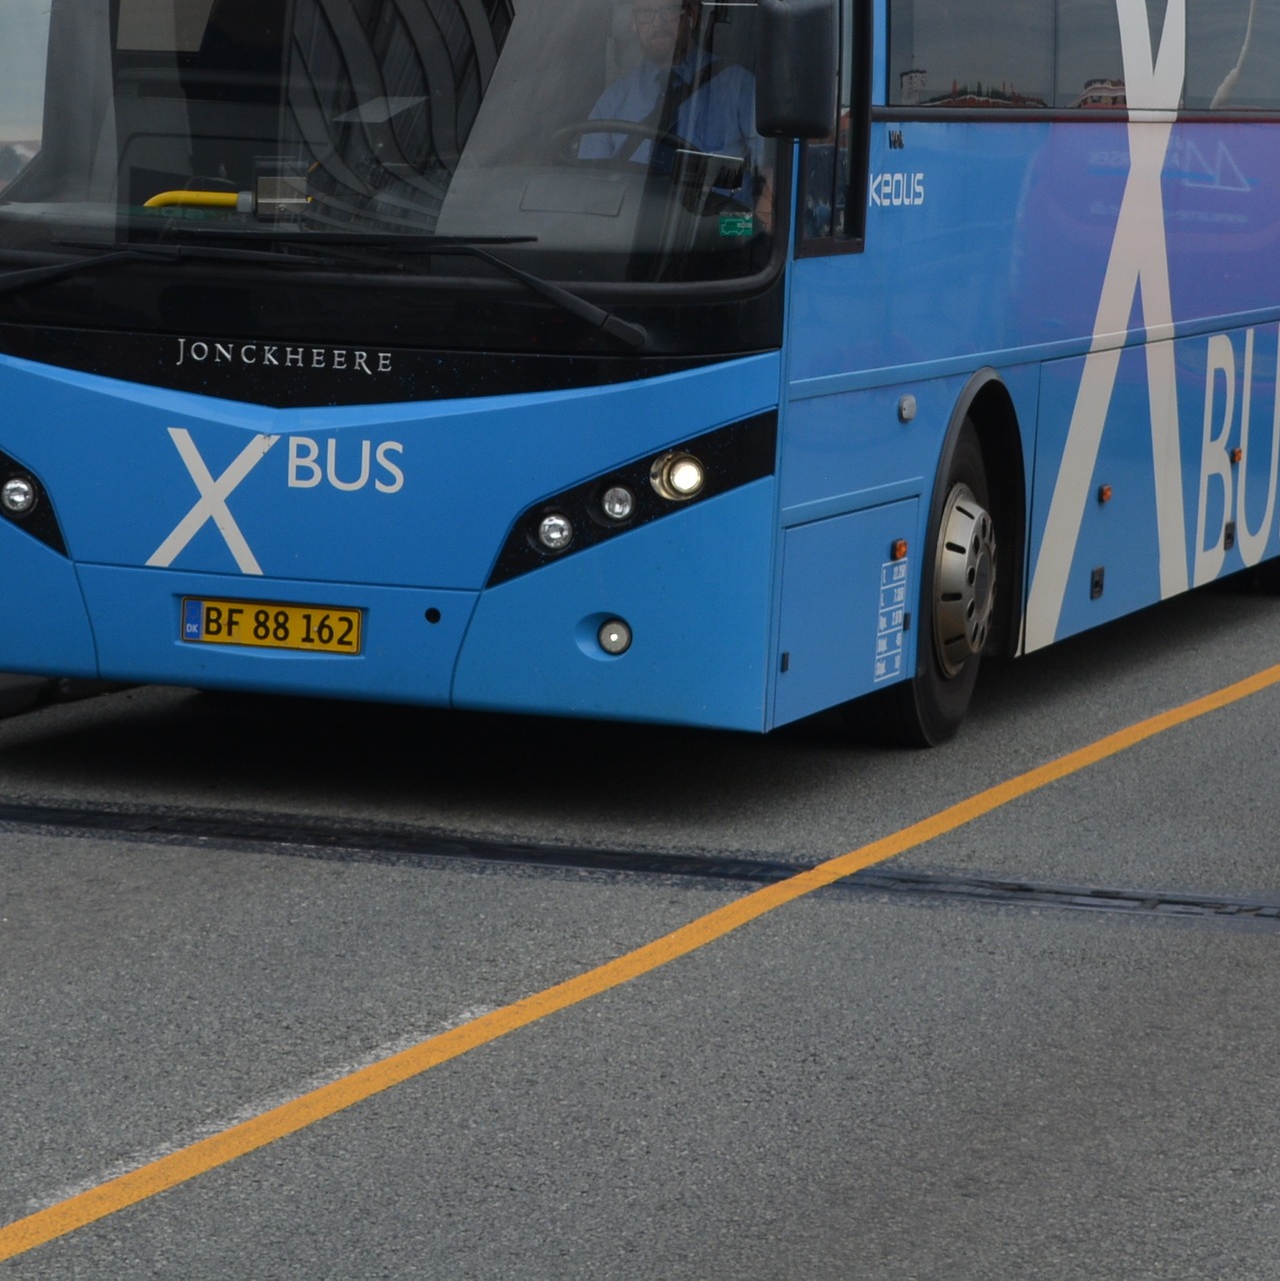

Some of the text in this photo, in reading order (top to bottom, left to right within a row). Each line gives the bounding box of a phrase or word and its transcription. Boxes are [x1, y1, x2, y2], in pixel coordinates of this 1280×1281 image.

[176, 338, 392, 375] JONCKHEERE
[144, 427, 405, 576] X BUS
[186, 623, 199, 634] DK
[205, 606, 354, 646] BF 88 162
